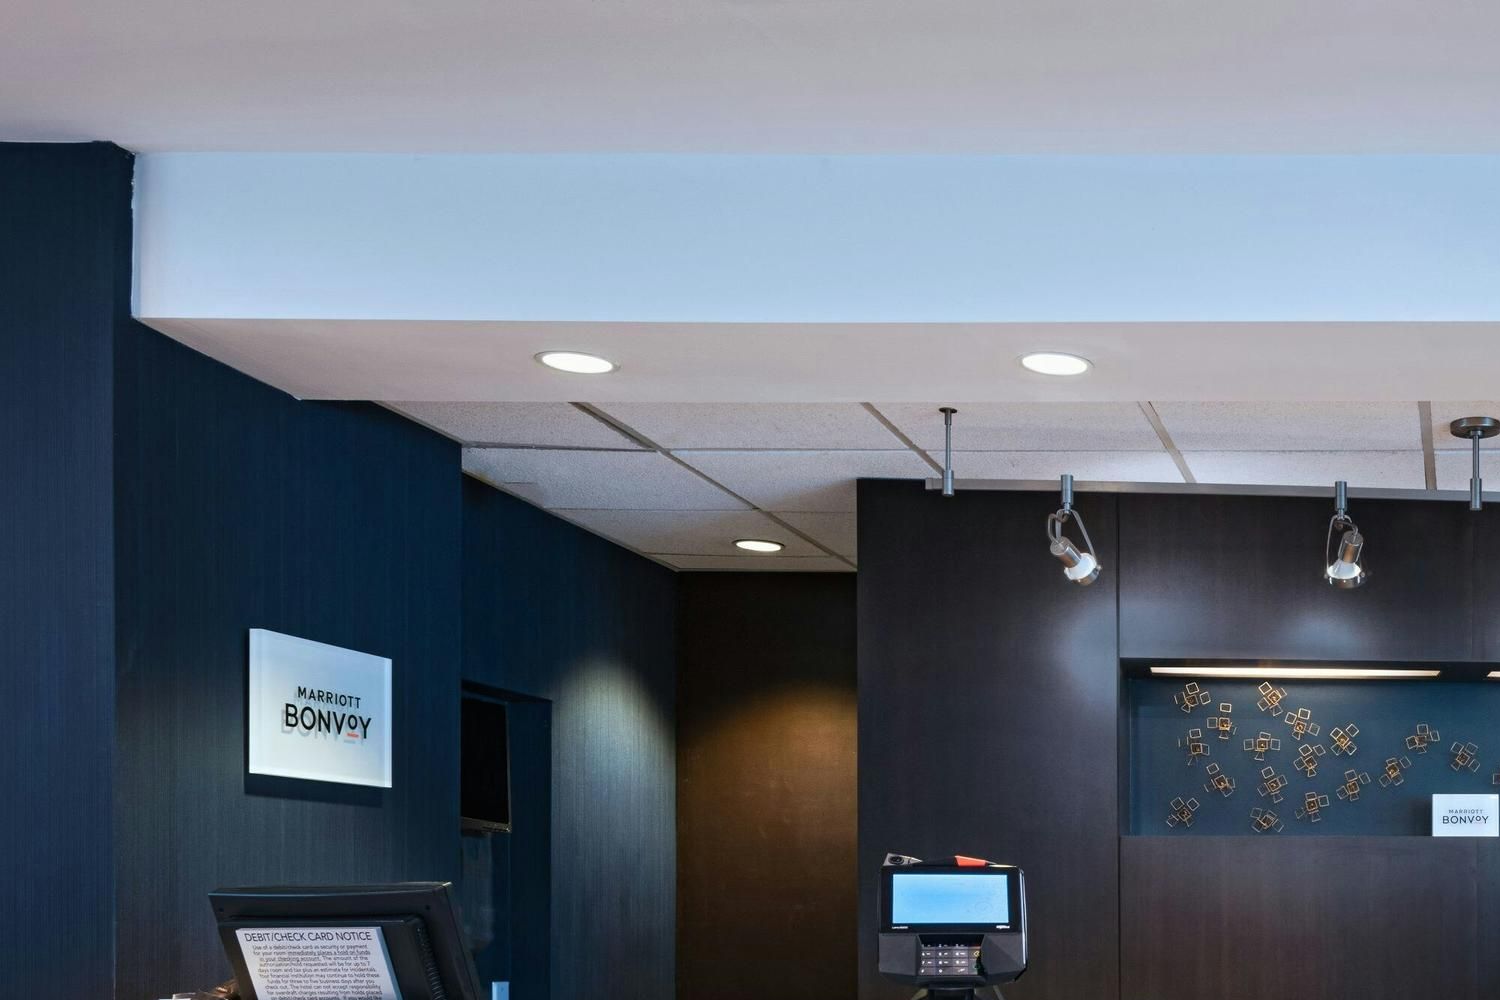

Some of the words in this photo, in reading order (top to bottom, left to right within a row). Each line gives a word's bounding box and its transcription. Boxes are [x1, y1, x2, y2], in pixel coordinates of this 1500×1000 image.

[297, 686, 361, 709] MARRIOTT
[244, 932, 306, 942] DEBIT/CHECK
[307, 932, 334, 941] CARD
[335, 931, 373, 941] NOTICE
